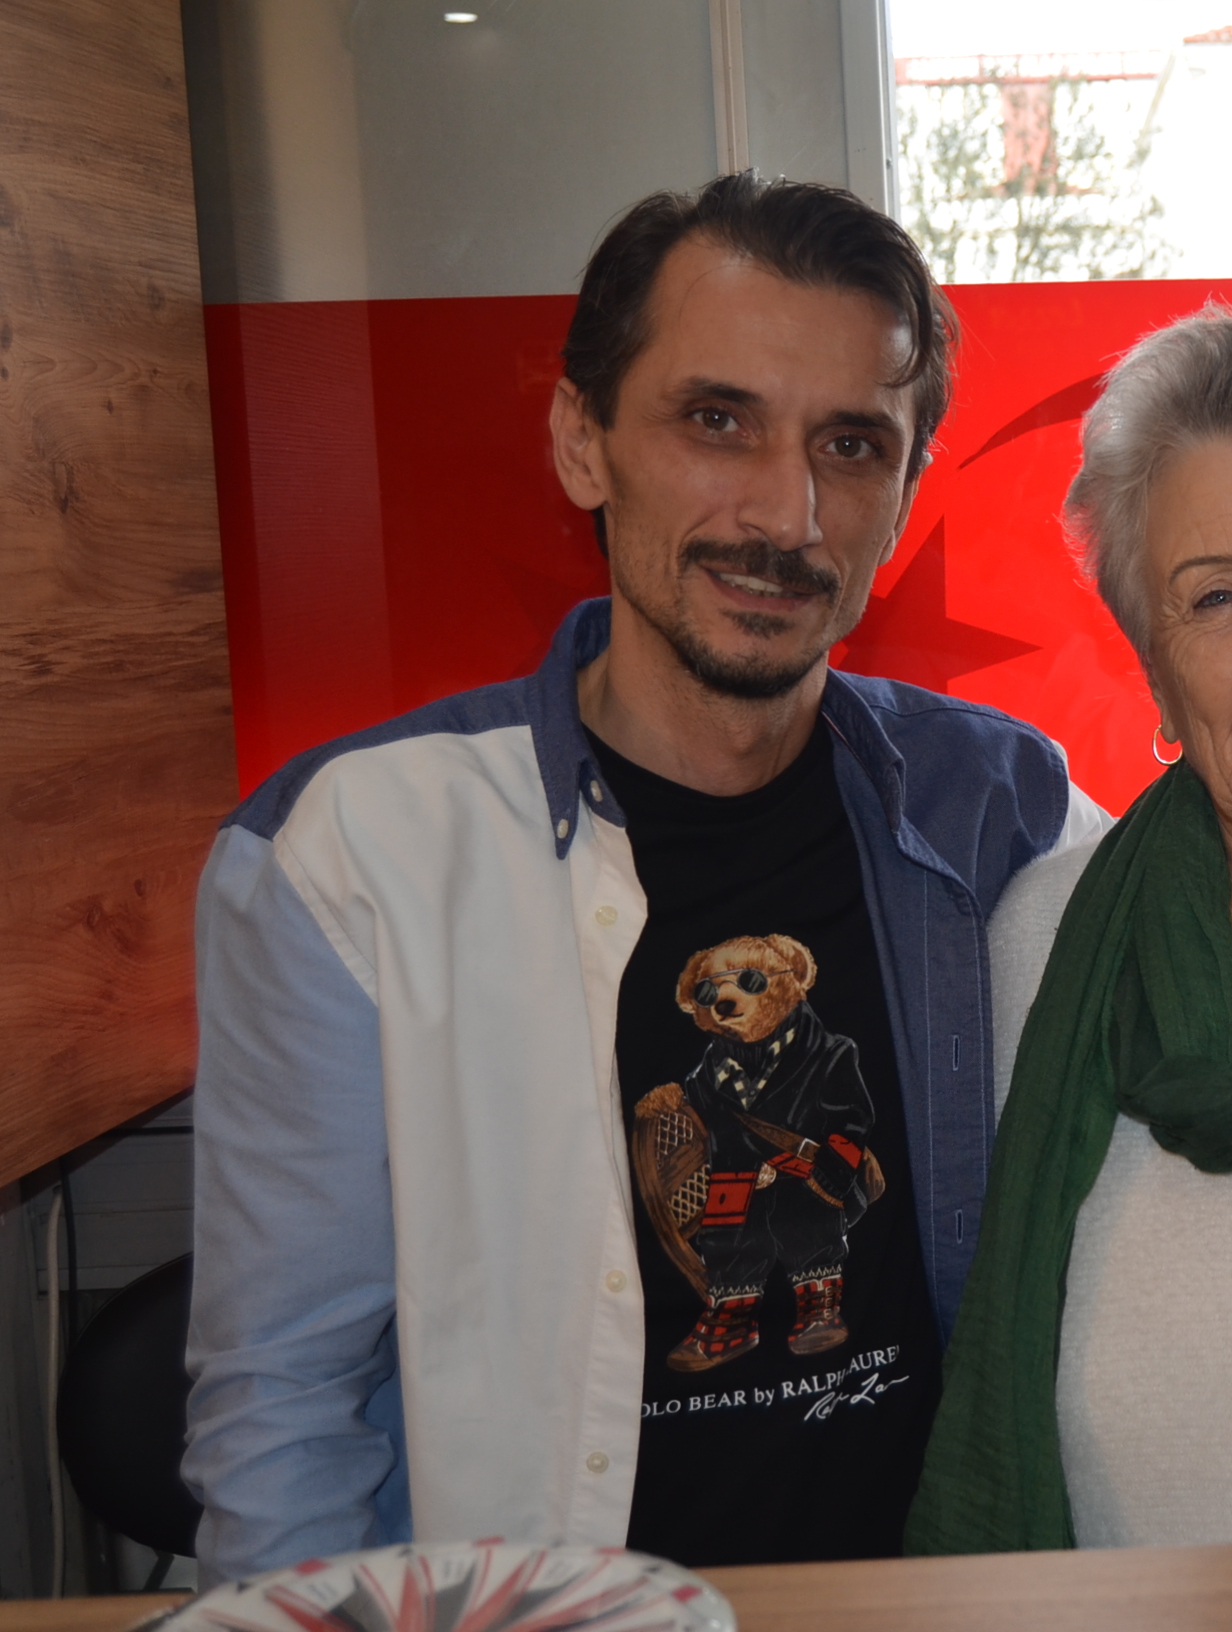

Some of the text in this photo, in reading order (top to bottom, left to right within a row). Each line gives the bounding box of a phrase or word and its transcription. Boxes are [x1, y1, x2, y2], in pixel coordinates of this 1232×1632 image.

[641, 1399, 681, 1417] OLO
[688, 1390, 746, 1411] BEAR
[754, 1388, 775, 1406] by
[846, 1345, 900, 1374] AURE
